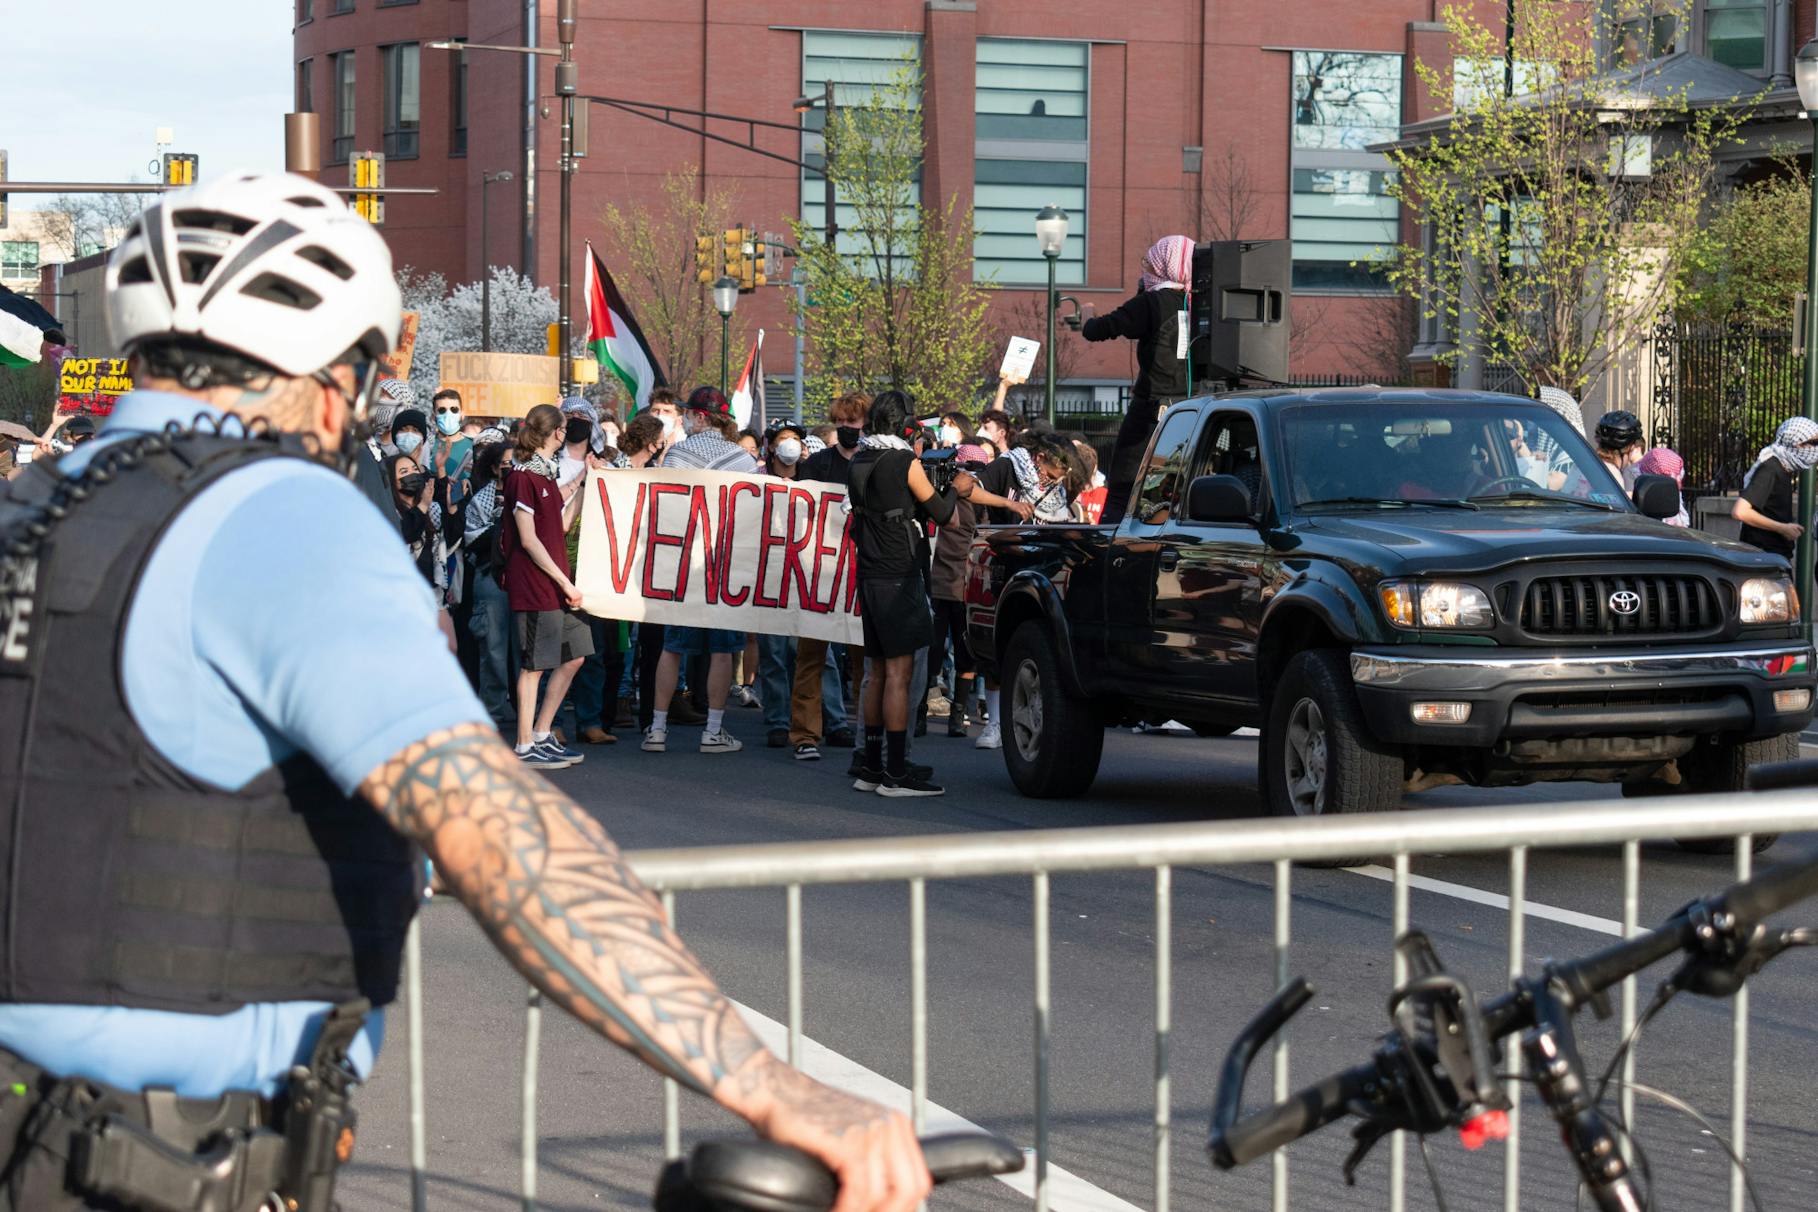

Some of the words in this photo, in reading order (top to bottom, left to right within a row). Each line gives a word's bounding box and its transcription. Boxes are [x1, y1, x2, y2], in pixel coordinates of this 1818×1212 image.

[61, 358, 101, 375] NOT
[442, 354, 493, 381] FUCK
[61, 375, 97, 391] OUR
[597, 477, 863, 617] VENCEREM
